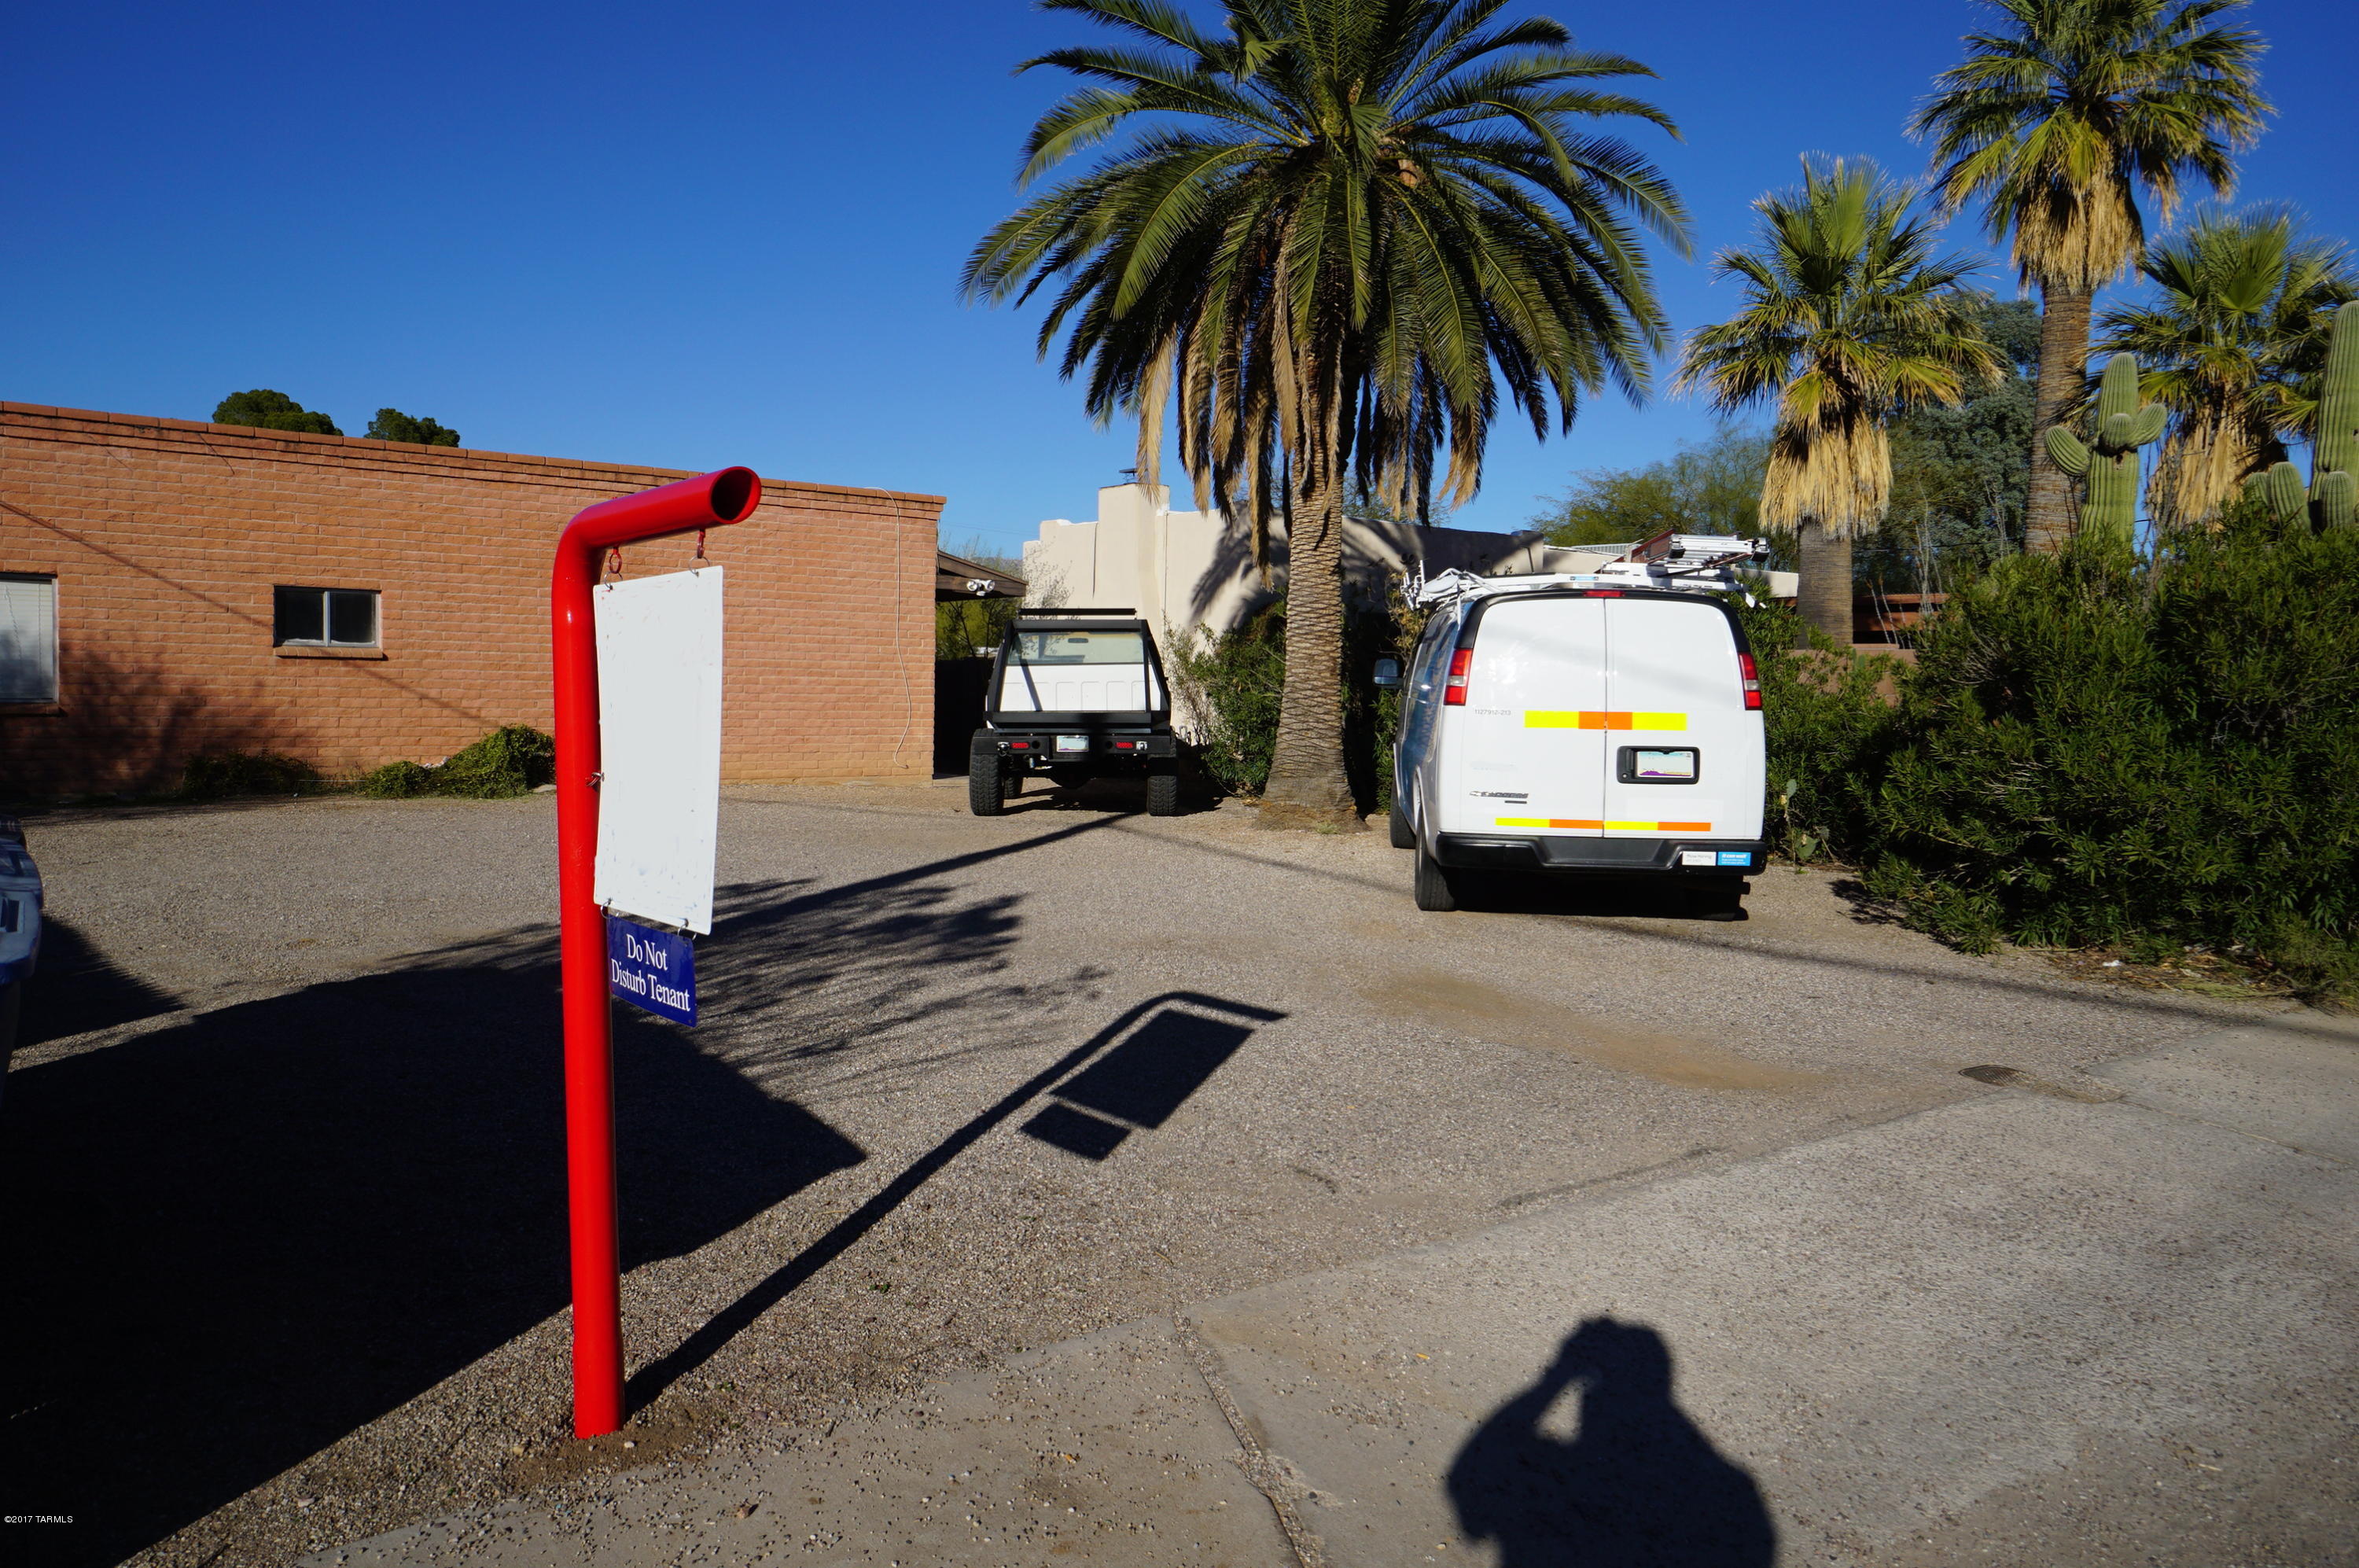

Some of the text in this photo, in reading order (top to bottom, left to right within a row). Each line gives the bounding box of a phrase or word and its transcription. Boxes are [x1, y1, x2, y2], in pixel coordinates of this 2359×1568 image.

[627, 933, 668, 971] Do Not
[611, 958, 691, 1012] Disturb Tenant
